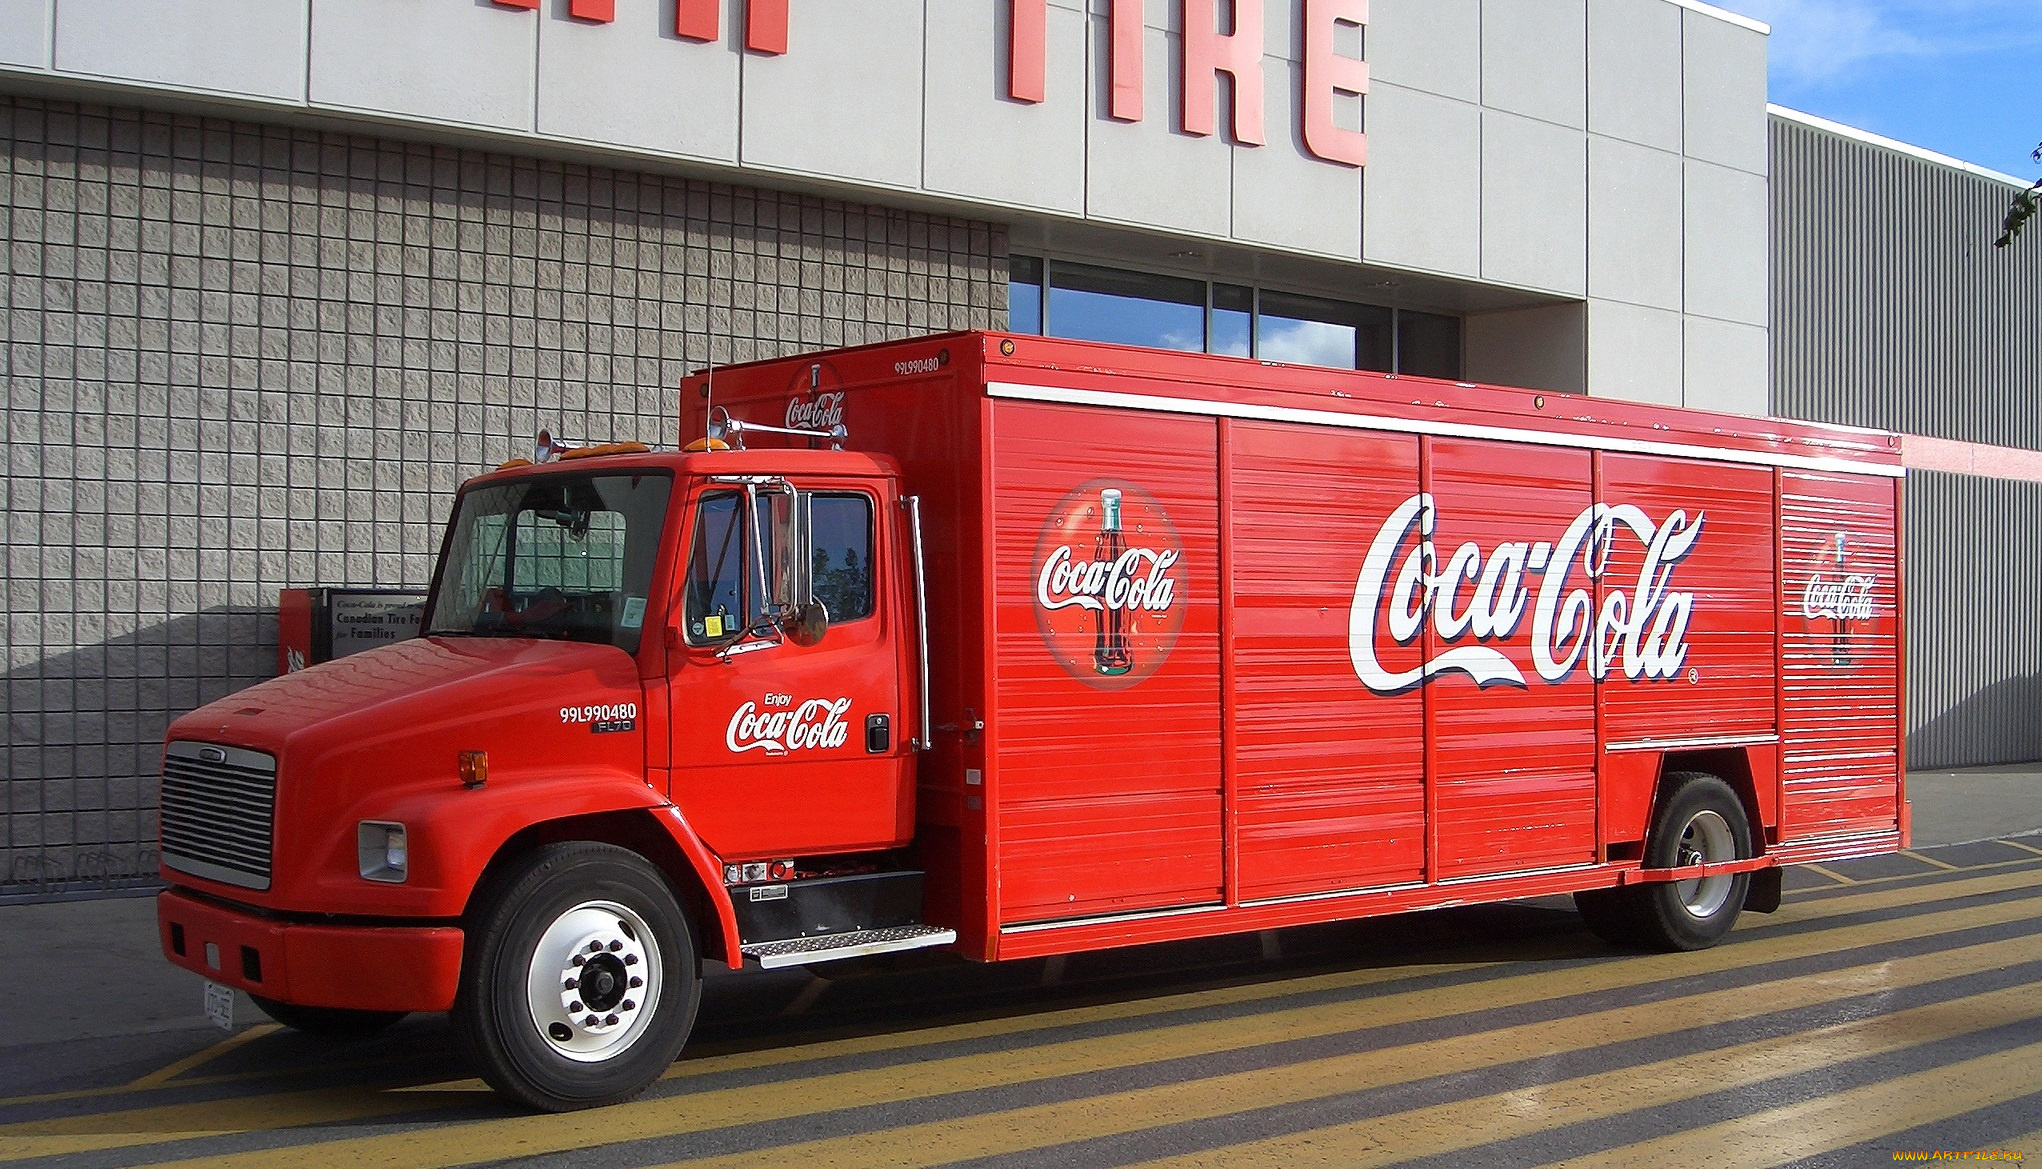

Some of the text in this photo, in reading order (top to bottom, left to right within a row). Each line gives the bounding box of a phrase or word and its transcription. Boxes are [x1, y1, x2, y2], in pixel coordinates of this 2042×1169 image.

[894, 357, 939, 375] 99L990480
[785, 391, 845, 429] Coca-Cola
[1038, 545, 1180, 611] Coca-Cola
[1348, 492, 1706, 693] Coca-Cola
[336, 612, 383, 625] Canadian
[387, 613, 406, 625] Tire
[350, 627, 395, 639] Families
[764, 692, 793, 707] Enjoy
[559, 702, 637, 724] 99L990480
[597, 720, 632, 732] FL70
[725, 697, 853, 753] Coca-Cola
